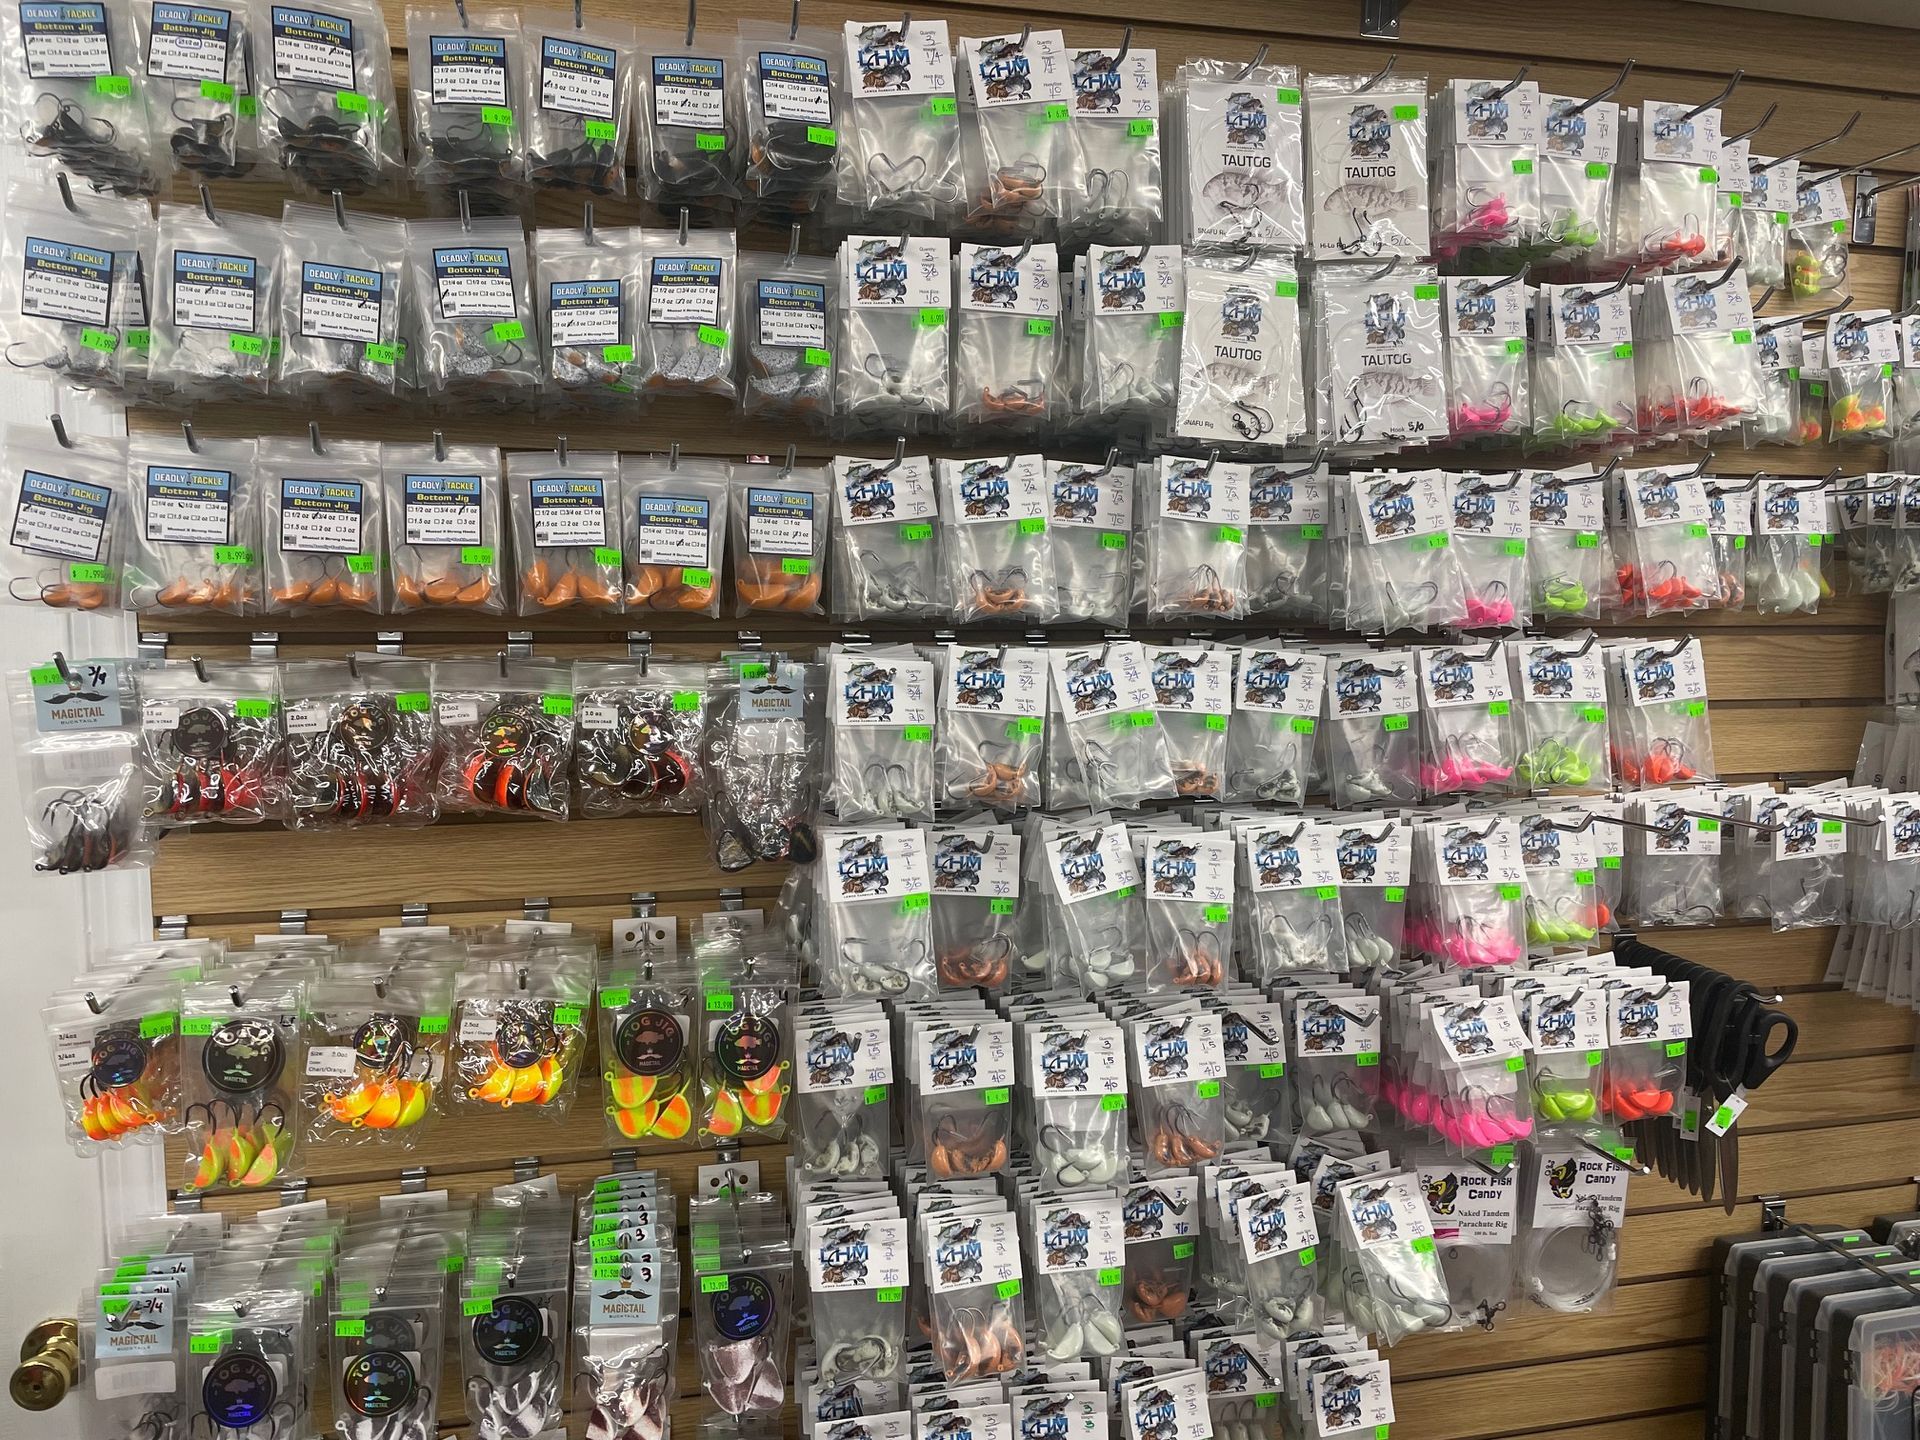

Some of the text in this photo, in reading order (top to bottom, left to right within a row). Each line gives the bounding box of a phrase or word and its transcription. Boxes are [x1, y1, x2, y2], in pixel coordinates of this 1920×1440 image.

[27, 9, 96, 18] DEADLY TACKLE
[158, 9, 223, 25] DEADLY TACKLE
[78, 23, 93, 31] Jig
[279, 13, 344, 32] DEADLY TACKLE
[163, 24, 217, 37] Bottom Jig
[284, 27, 340, 44] Bottom Jig
[549, 45, 609, 63] DEADLY TACKLE
[480, 56, 493, 65] Jig
[766, 58, 821, 71] DEADLY TACKLE
[554, 59, 604, 74] Bottom Jig
[659, 63, 716, 73] DEADLY TACKLE
[664, 75, 713, 86] Bottom Jig
[771, 71, 818, 82] Bottom Jig
[1221, 153, 1271, 168] TAUTOG
[1345, 166, 1396, 178] TAUTOG
[32, 245, 104, 265] DEADLY TACKLE
[440, 255, 469, 263] DEADLY
[37, 259, 97, 277] Bottom Jig
[182, 259, 248, 273] DEADLY TACKLE
[486, 267, 499, 275] Jig
[658, 263, 715, 272] DEADLY TACKLE
[186, 273, 243, 285] Bottom Jig
[309, 269, 375, 286] DEADLY TACKLE
[698, 276, 710, 284] Jig
[314, 283, 369, 298] Bottom Jig
[556, 286, 614, 295] DEADLY TACKLE
[764, 286, 818, 297] DEADLY TACKLE
[561, 297, 609, 306] Bottom Jig
[769, 298, 814, 309] Bottom Jig
[1214, 345, 1262, 361] TAUTOG
[1361, 353, 1412, 366] TAUTOG
[1407, 422, 1424, 432] 5/0
[154, 473, 223, 485] DEADLY TACKLE
[30, 479, 102, 501] DEADLY TACKLE
[411, 481, 474, 490] DEADLY TACKLE
[537, 484, 596, 493] DEADLY TACKLE
[159, 487, 217, 498] Bottom Jig
[289, 486, 355, 497] DEADLY TACKLE
[33, 493, 93, 513] Bottom Jig
[294, 499, 349, 510] Bottom Jig
[455, 495, 469, 503] Jig
[579, 496, 592, 505] Jig
[754, 494, 808, 506] DEADLY TACKLE
[645, 503, 702, 514] DEADLY TACKLE
[758, 506, 804, 516] Bottom Jig
[685, 517, 698, 526] Jig
[751, 698, 792, 708] MAGICTAIL
[51, 707, 105, 720] MAGICTAIL
[1597, 1194, 1622, 1202] Tandem
[603, 1304, 646, 1313] MAGICTAIL
[110, 1334, 159, 1347] MAGICTAIL
